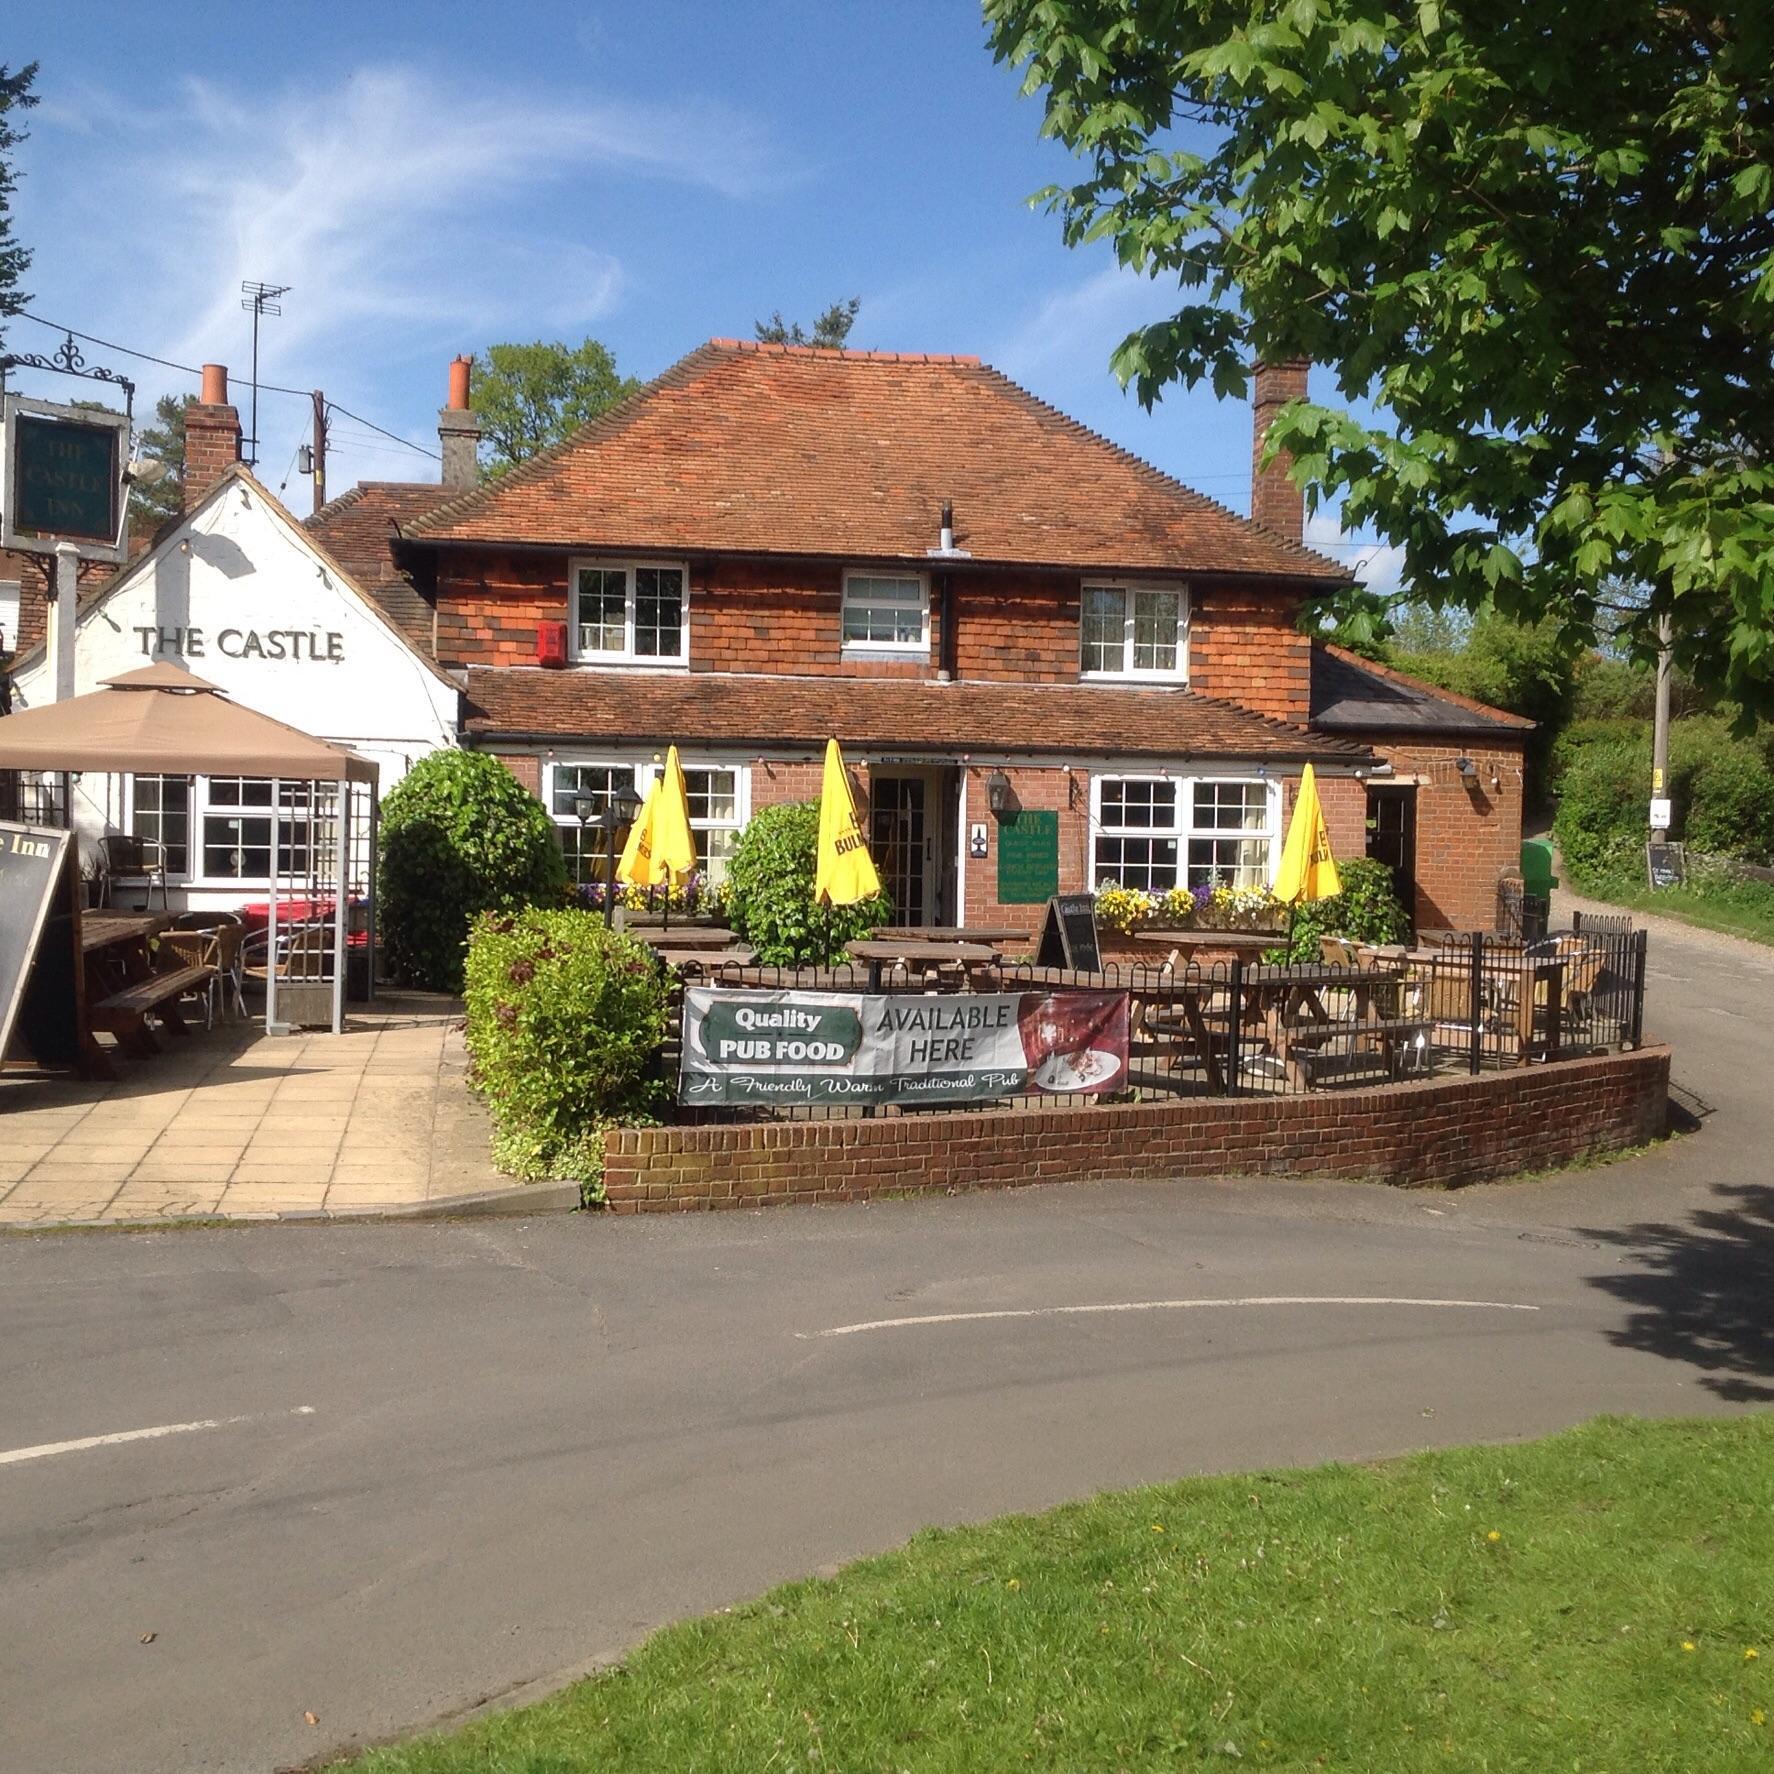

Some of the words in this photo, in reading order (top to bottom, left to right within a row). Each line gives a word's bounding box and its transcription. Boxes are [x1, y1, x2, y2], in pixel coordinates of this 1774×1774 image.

[133, 626, 205, 657] THE
[217, 628, 345, 661] CASTLE
[9, 834, 50, 858] Inn
[735, 1008, 822, 1032] Quality
[877, 1004, 1010, 1031] AVAILABLE
[720, 1040, 771, 1059] PUB
[775, 1041, 845, 1060] FOOD
[910, 1037, 975, 1063] HERE
[689, 1077, 722, 1093] A
[730, 1076, 812, 1098] Friendly
[890, 1075, 976, 1092] Traditional
[981, 1072, 1021, 1089] Pub
